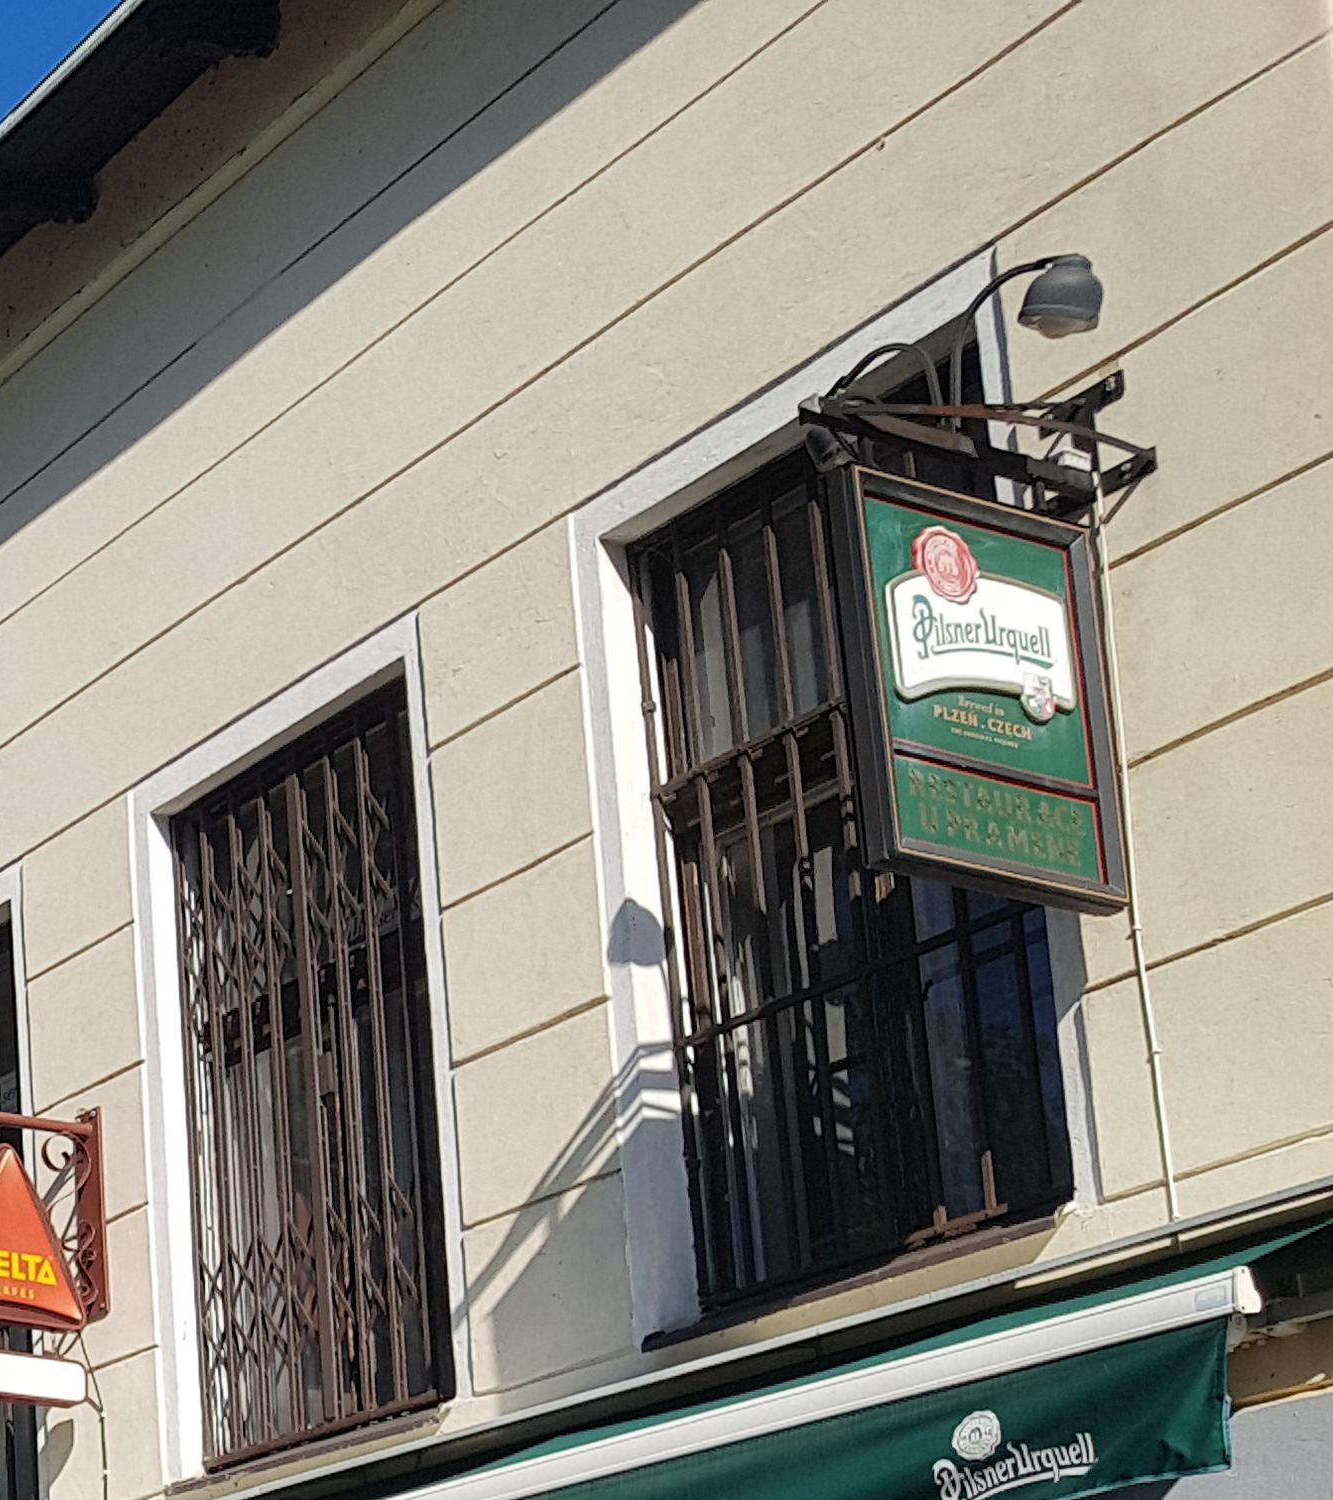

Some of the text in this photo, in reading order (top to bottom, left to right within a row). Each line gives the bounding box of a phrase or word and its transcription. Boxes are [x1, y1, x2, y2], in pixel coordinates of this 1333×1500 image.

[912, 594, 1053, 665] Pilsner Urquell
[988, 718, 1032, 741] CZECH
[1007, 1432, 1099, 1484] Urquell
